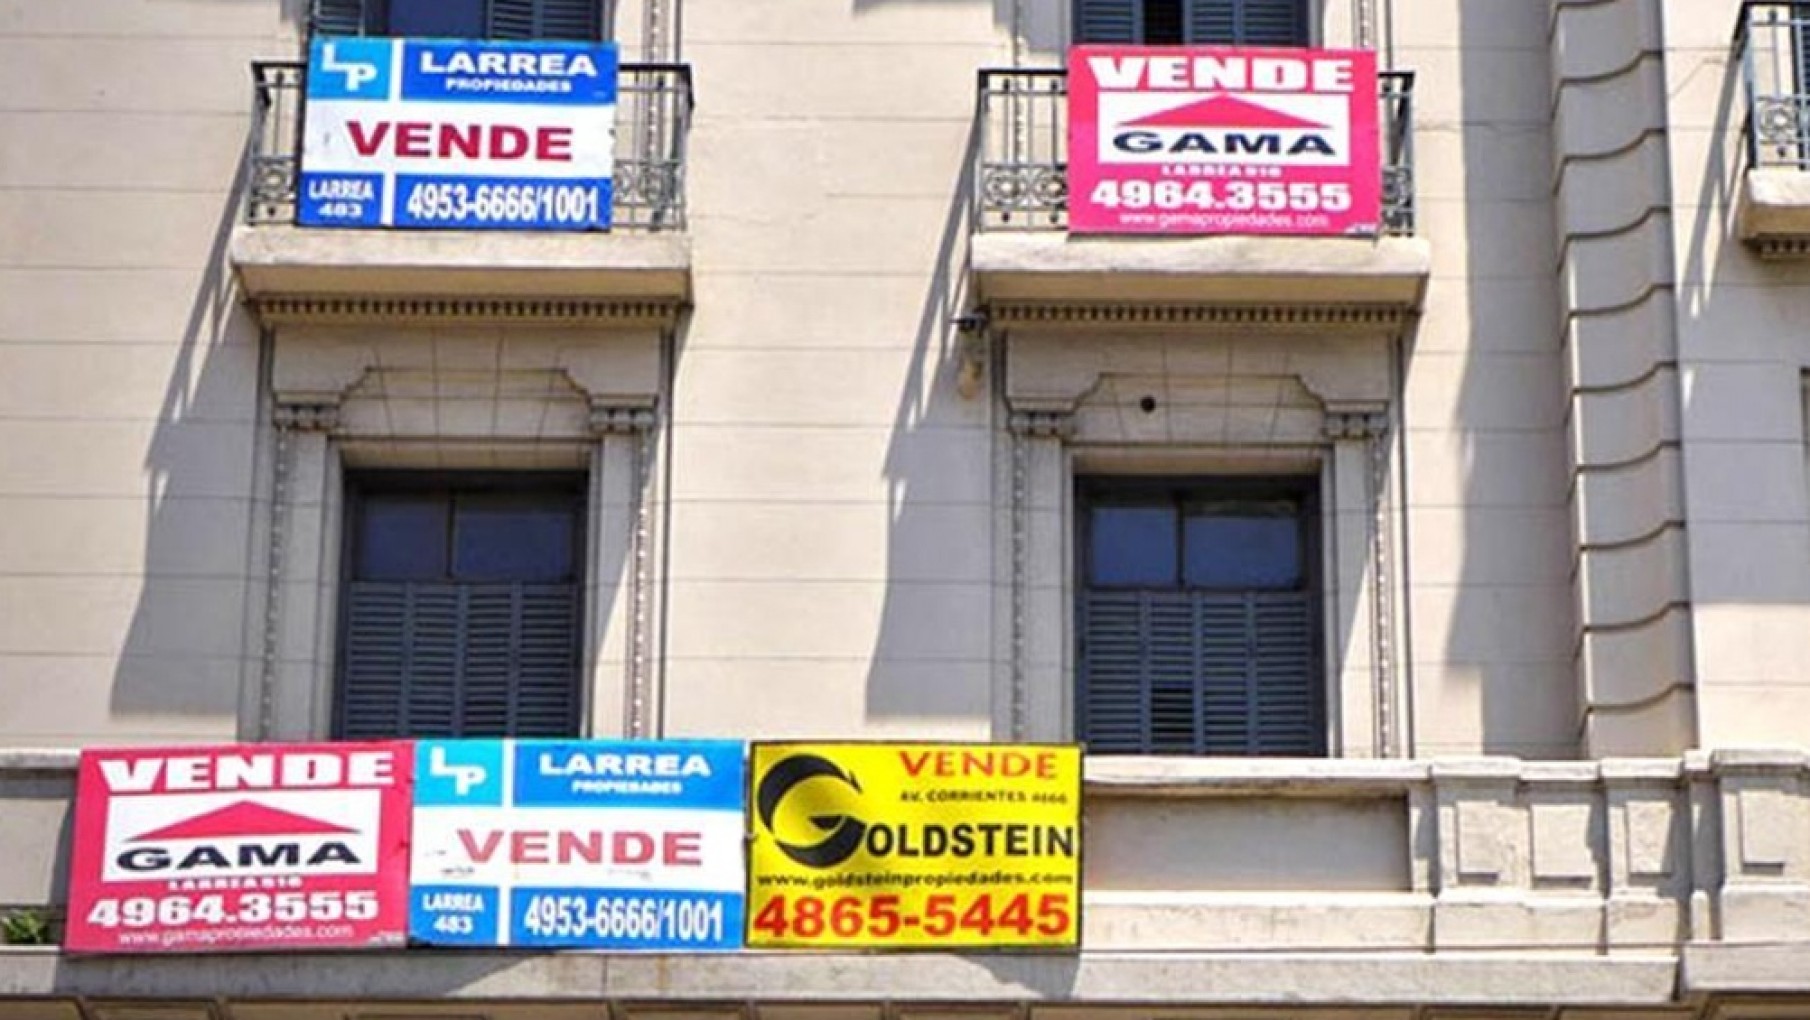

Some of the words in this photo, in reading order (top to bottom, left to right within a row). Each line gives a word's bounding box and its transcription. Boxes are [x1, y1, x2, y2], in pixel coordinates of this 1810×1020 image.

[321, 44, 377, 91] LP
[420, 51, 598, 76] LARREA
[1087, 56, 1354, 91] VENDE
[445, 77, 572, 92] PROPIEDADES
[346, 120, 573, 162] VENDE
[1112, 131, 1336, 155] GAMA
[309, 180, 373, 200] LARREA
[407, 182, 599, 223] 4953-6666/1001
[1090, 179, 1352, 212] 4964.3555
[1118, 212, 1330, 228] www.gamapropiedades.com
[98, 752, 395, 792] VENDE
[430, 747, 487, 796] LP
[539, 753, 712, 776] LARREA
[899, 751, 1058, 779] VENDE
[572, 780, 682, 794] PROPIEDADES
[926, 788, 1026, 803] CORRIENTES
[116, 842, 361, 871] GAMA
[457, 829, 702, 866] VENDE
[757, 872, 1072, 889] www.goldsteinpropiedades.com
[86, 890, 379, 928] 4964.3555
[422, 893, 484, 911] LARREA
[753, 894, 1070, 938] 4865-5445
[523, 895, 724, 942] 4953-6666/1001
[119, 925, 354, 946] www.gamapropiedades.com
